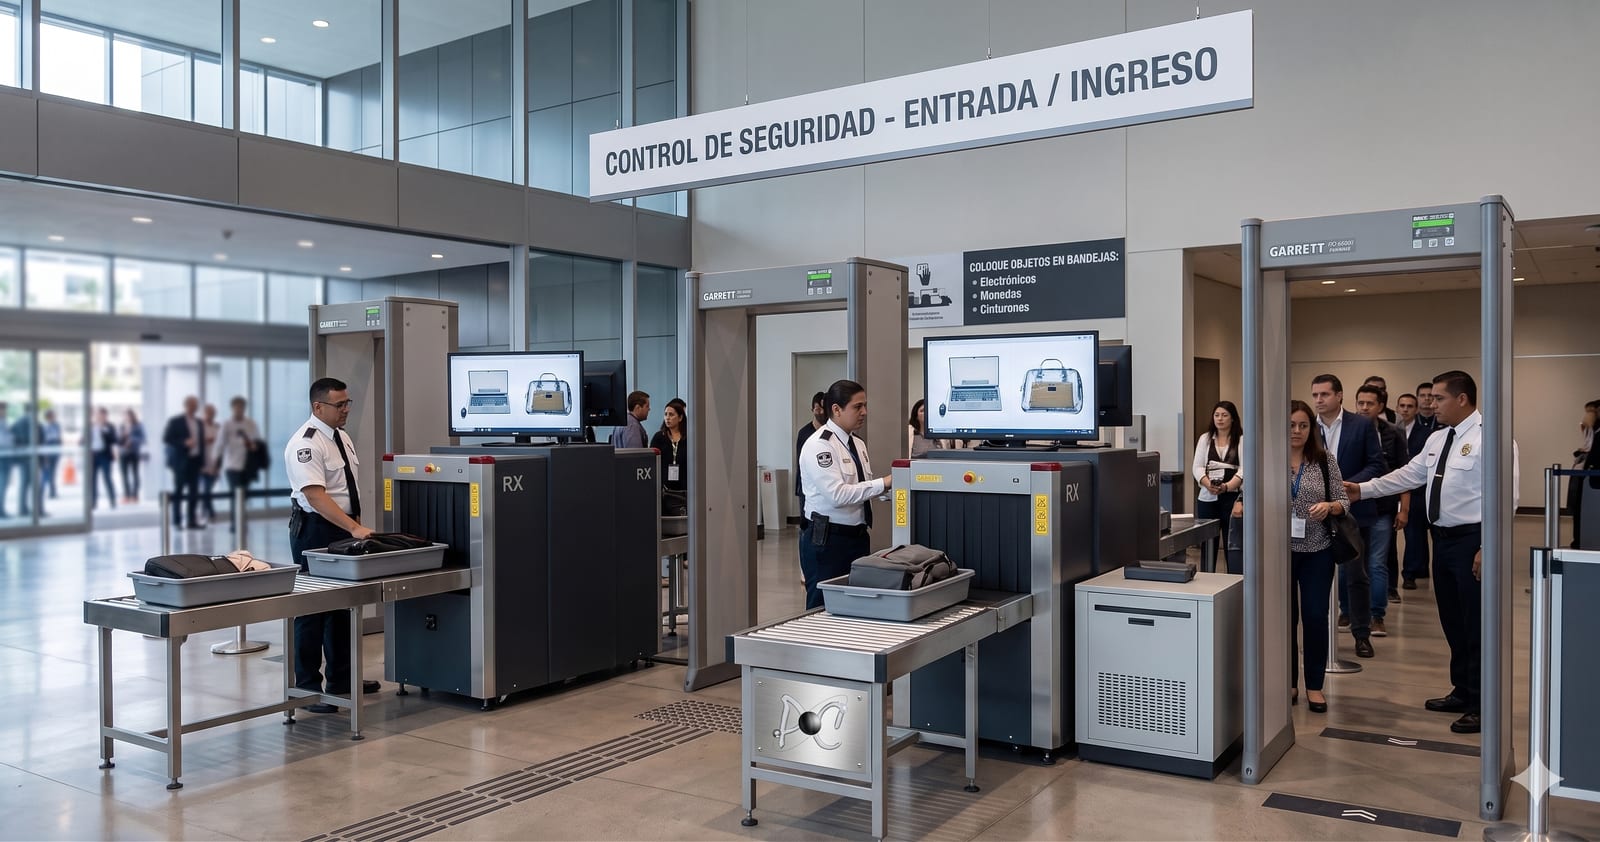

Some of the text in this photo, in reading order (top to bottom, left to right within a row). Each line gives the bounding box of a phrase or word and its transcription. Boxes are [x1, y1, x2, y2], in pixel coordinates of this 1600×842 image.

[605, 138, 698, 176] CONTROL
[705, 131, 733, 161] DE
[739, 107, 876, 156] SEGURIDAD
[904, 79, 1039, 129] ENTRADA
[1071, 46, 1219, 102] INGRESO
[1269, 242, 1325, 257] GARRETT
[969, 250, 1120, 273] COLOQUE OBJETOS EN BANDEJAS:
[980, 274, 1037, 287] Electrónicos
[703, 290, 736, 301] GARRETT
[980, 289, 1022, 301] Monedas
[980, 303, 1030, 315] Cinturones
[636, 467, 652, 481] RX
[1147, 473, 1157, 488] RX
[502, 475, 523, 492] RX
[1066, 482, 1079, 502] RX
